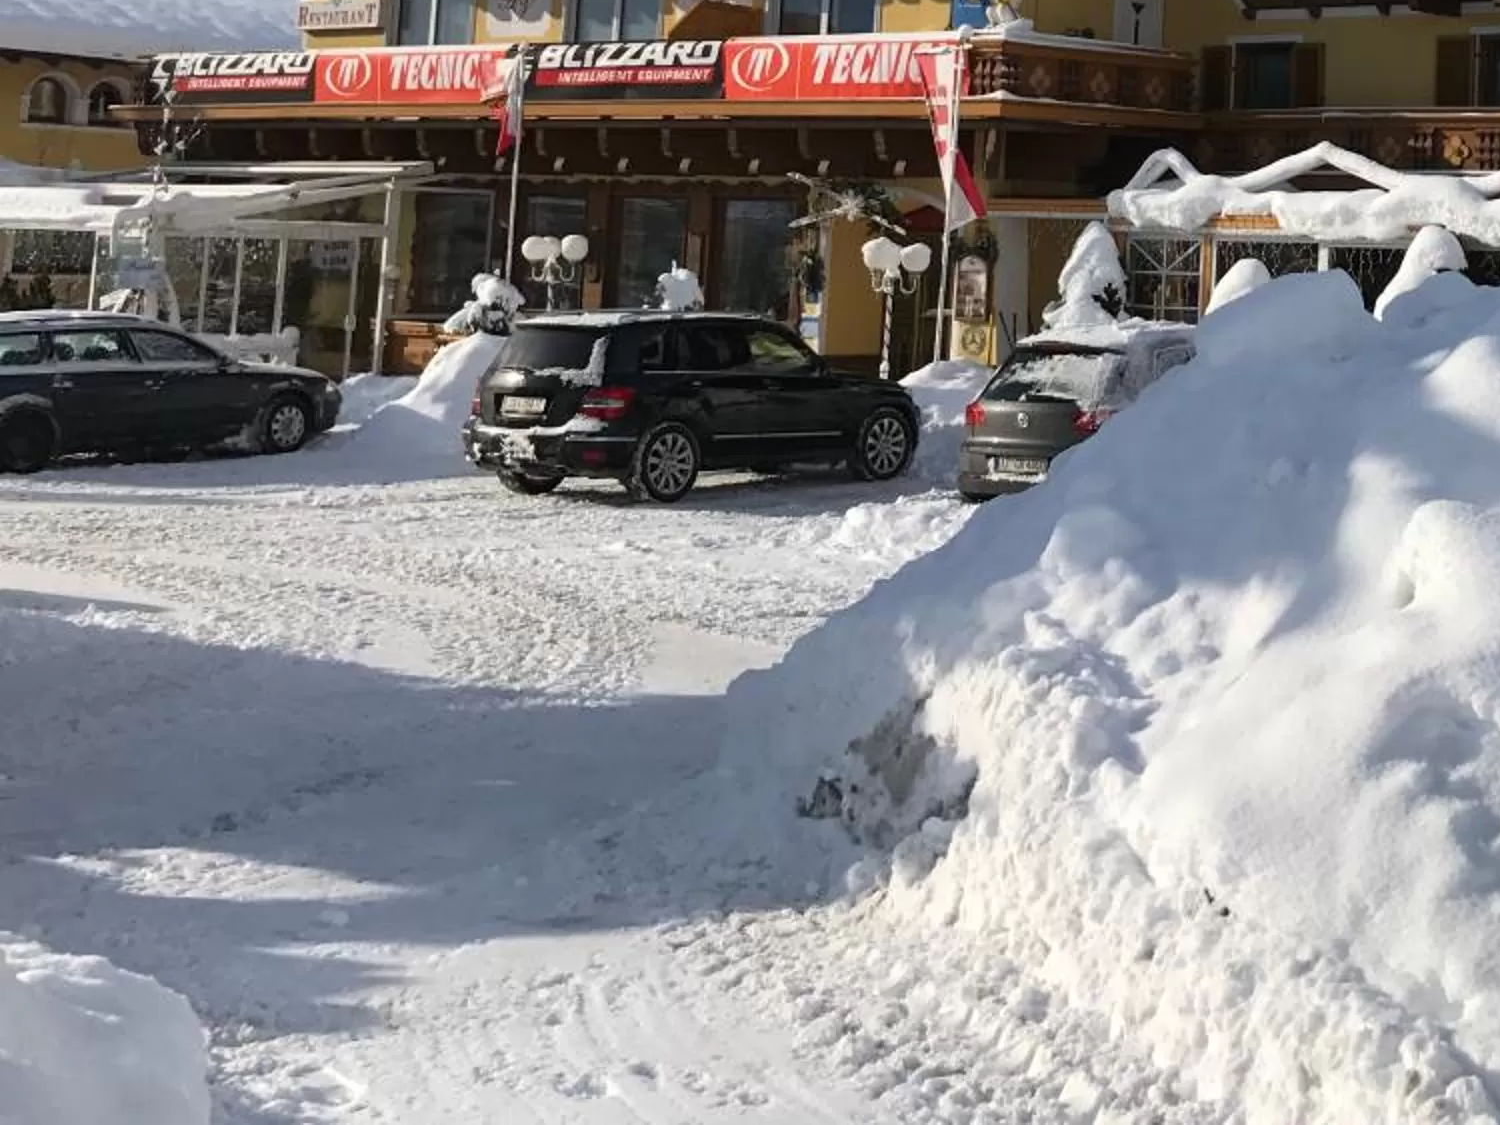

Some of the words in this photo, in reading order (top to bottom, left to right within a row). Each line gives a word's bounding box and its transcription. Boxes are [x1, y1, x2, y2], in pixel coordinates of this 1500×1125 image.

[298, 3, 377, 27] RESTAURANT
[174, 52, 314, 76] BLIZZARD
[538, 41, 721, 69] BLIZZARD
[187, 77, 246, 89] INTELLIGENT
[390, 52, 490, 91] TECNIC
[557, 71, 634, 83] INTELLIGENT
[637, 68, 712, 80] EQUIPMENT
